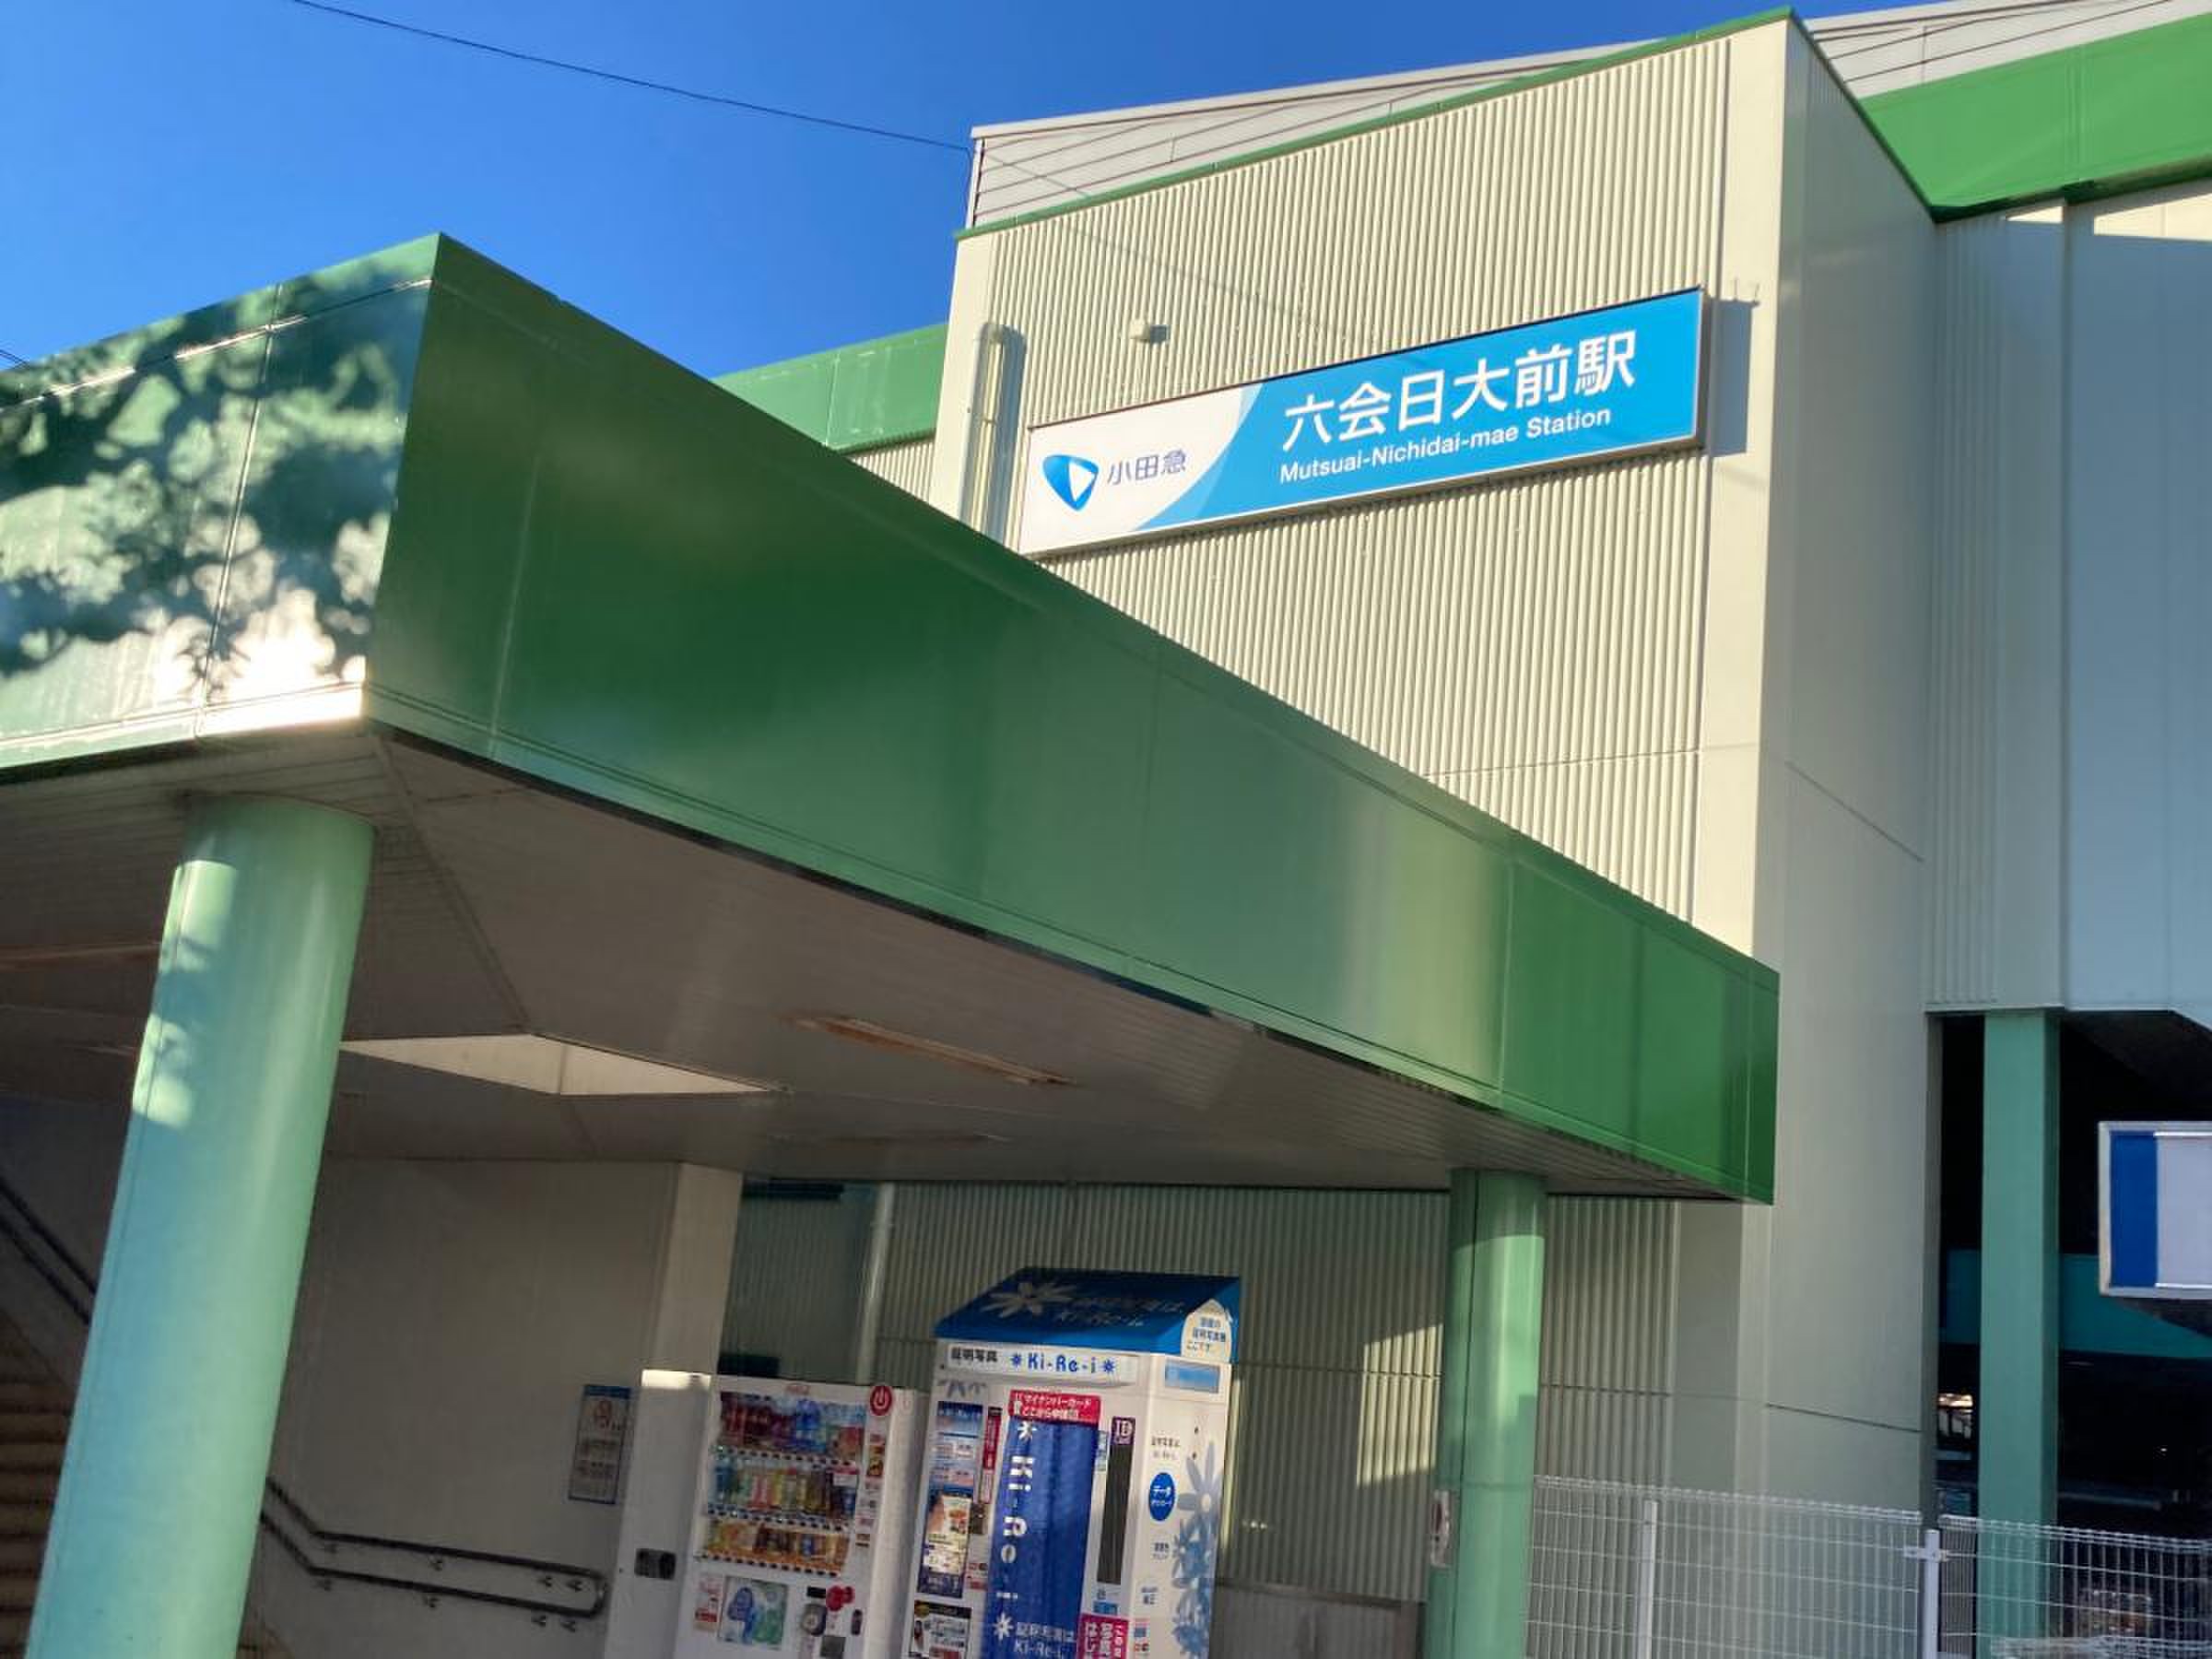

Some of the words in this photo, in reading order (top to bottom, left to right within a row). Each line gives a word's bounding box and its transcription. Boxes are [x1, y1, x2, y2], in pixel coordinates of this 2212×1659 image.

[1282, 329, 1636, 453] 六会日大前駅
[1279, 424, 1519, 485] Mutsuai-Nichidai-mae
[1526, 407, 1611, 439] Station
[1107, 449, 1186, 485] 小田急
[950, 1347, 997, 1364] 証明写真
[1028, 1352, 1097, 1373] Ki-Re-i
